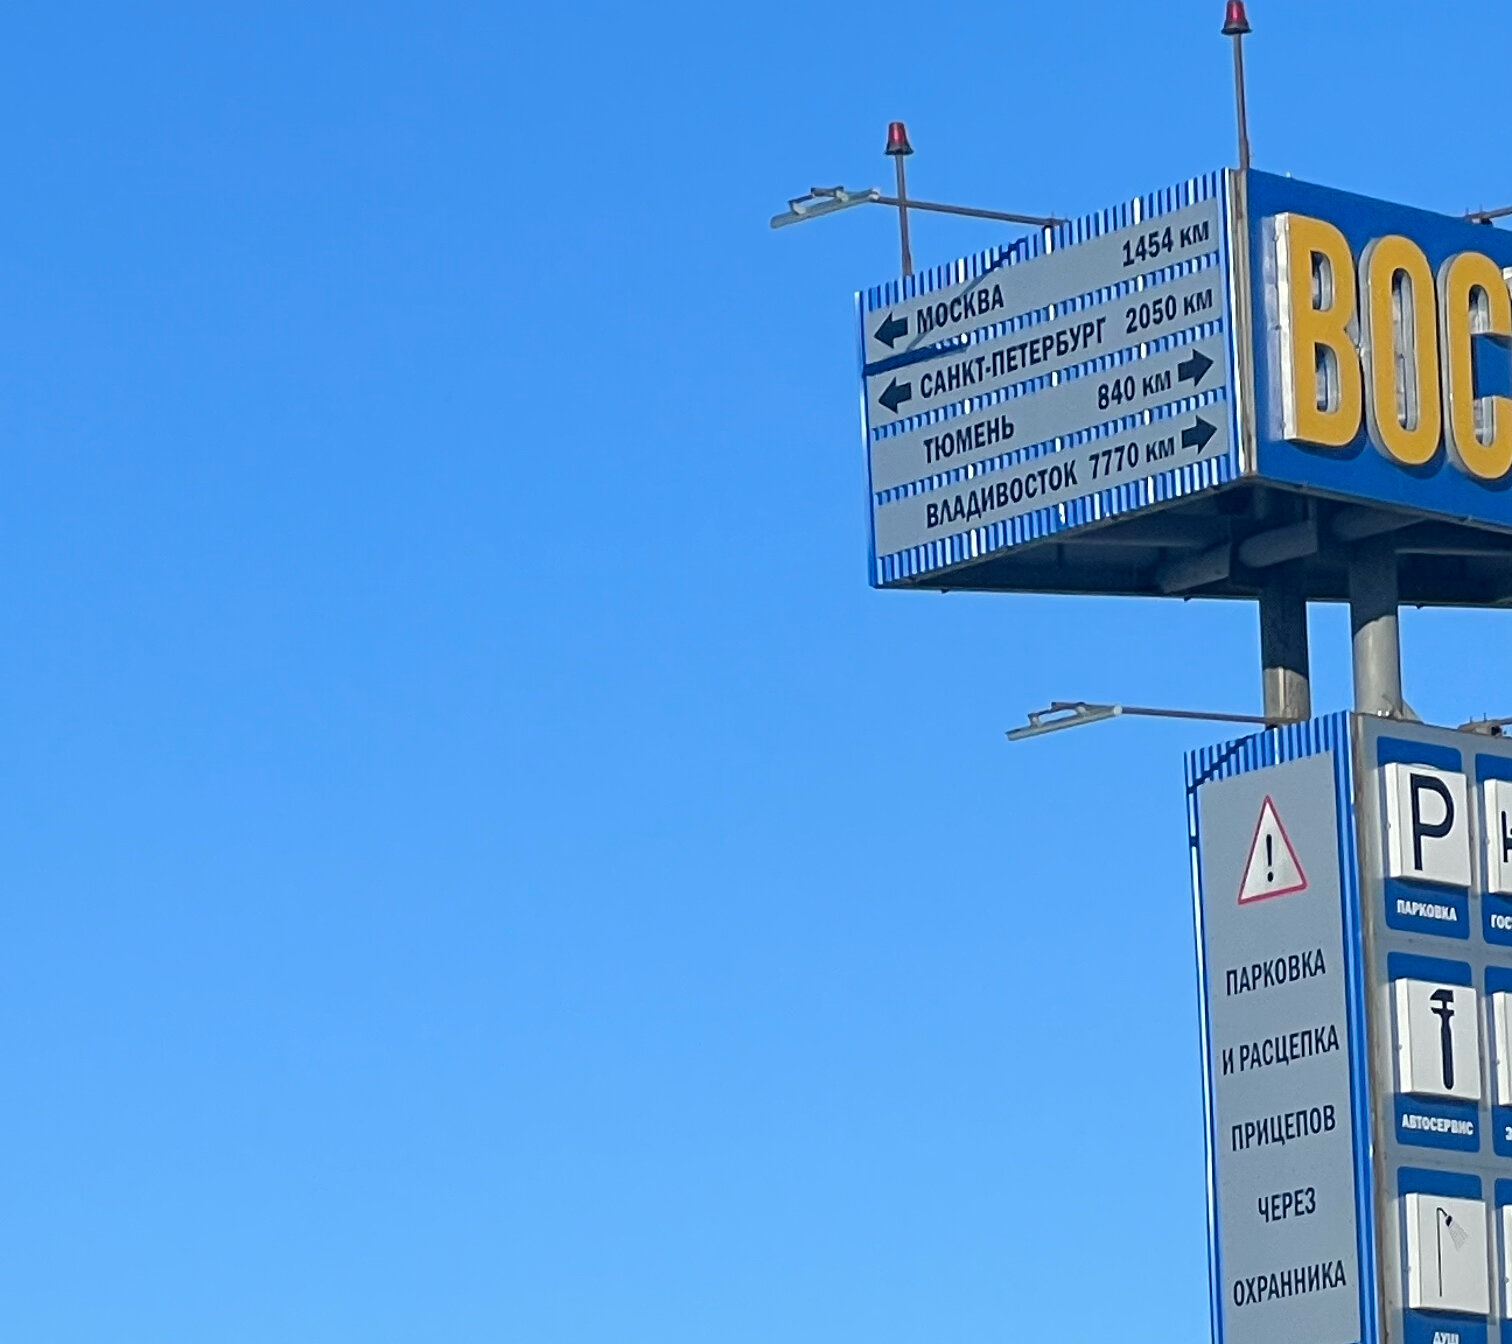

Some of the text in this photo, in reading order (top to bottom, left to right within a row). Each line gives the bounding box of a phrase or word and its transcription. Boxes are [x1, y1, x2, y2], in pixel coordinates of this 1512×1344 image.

[916, 220, 1210, 335] МОСКВА 1454 км
[920, 289, 1213, 399] САНКТ-ПЕТЕРБУРГ 2050 км
[924, 369, 1172, 464] ТЮМЕНЬ 840 км
[926, 435, 1175, 529] ВЛАДИВОСТОК 7770 км
[1410, 773, 1455, 872] P
[1397, 899, 1457, 922] ПАРКОВКА
[1226, 948, 1326, 996] ПАРКОВКА
[1222, 1024, 1340, 1076] И РАСЦЕПКА
[1231, 1103, 1337, 1152] ПРИЦЕПОВ
[1401, 1113, 1475, 1136] АВТОСЕРВИС
[1257, 1186, 1317, 1224] ЧЕРЕЗ
[1233, 1259, 1347, 1307] ОХРАННИКА
